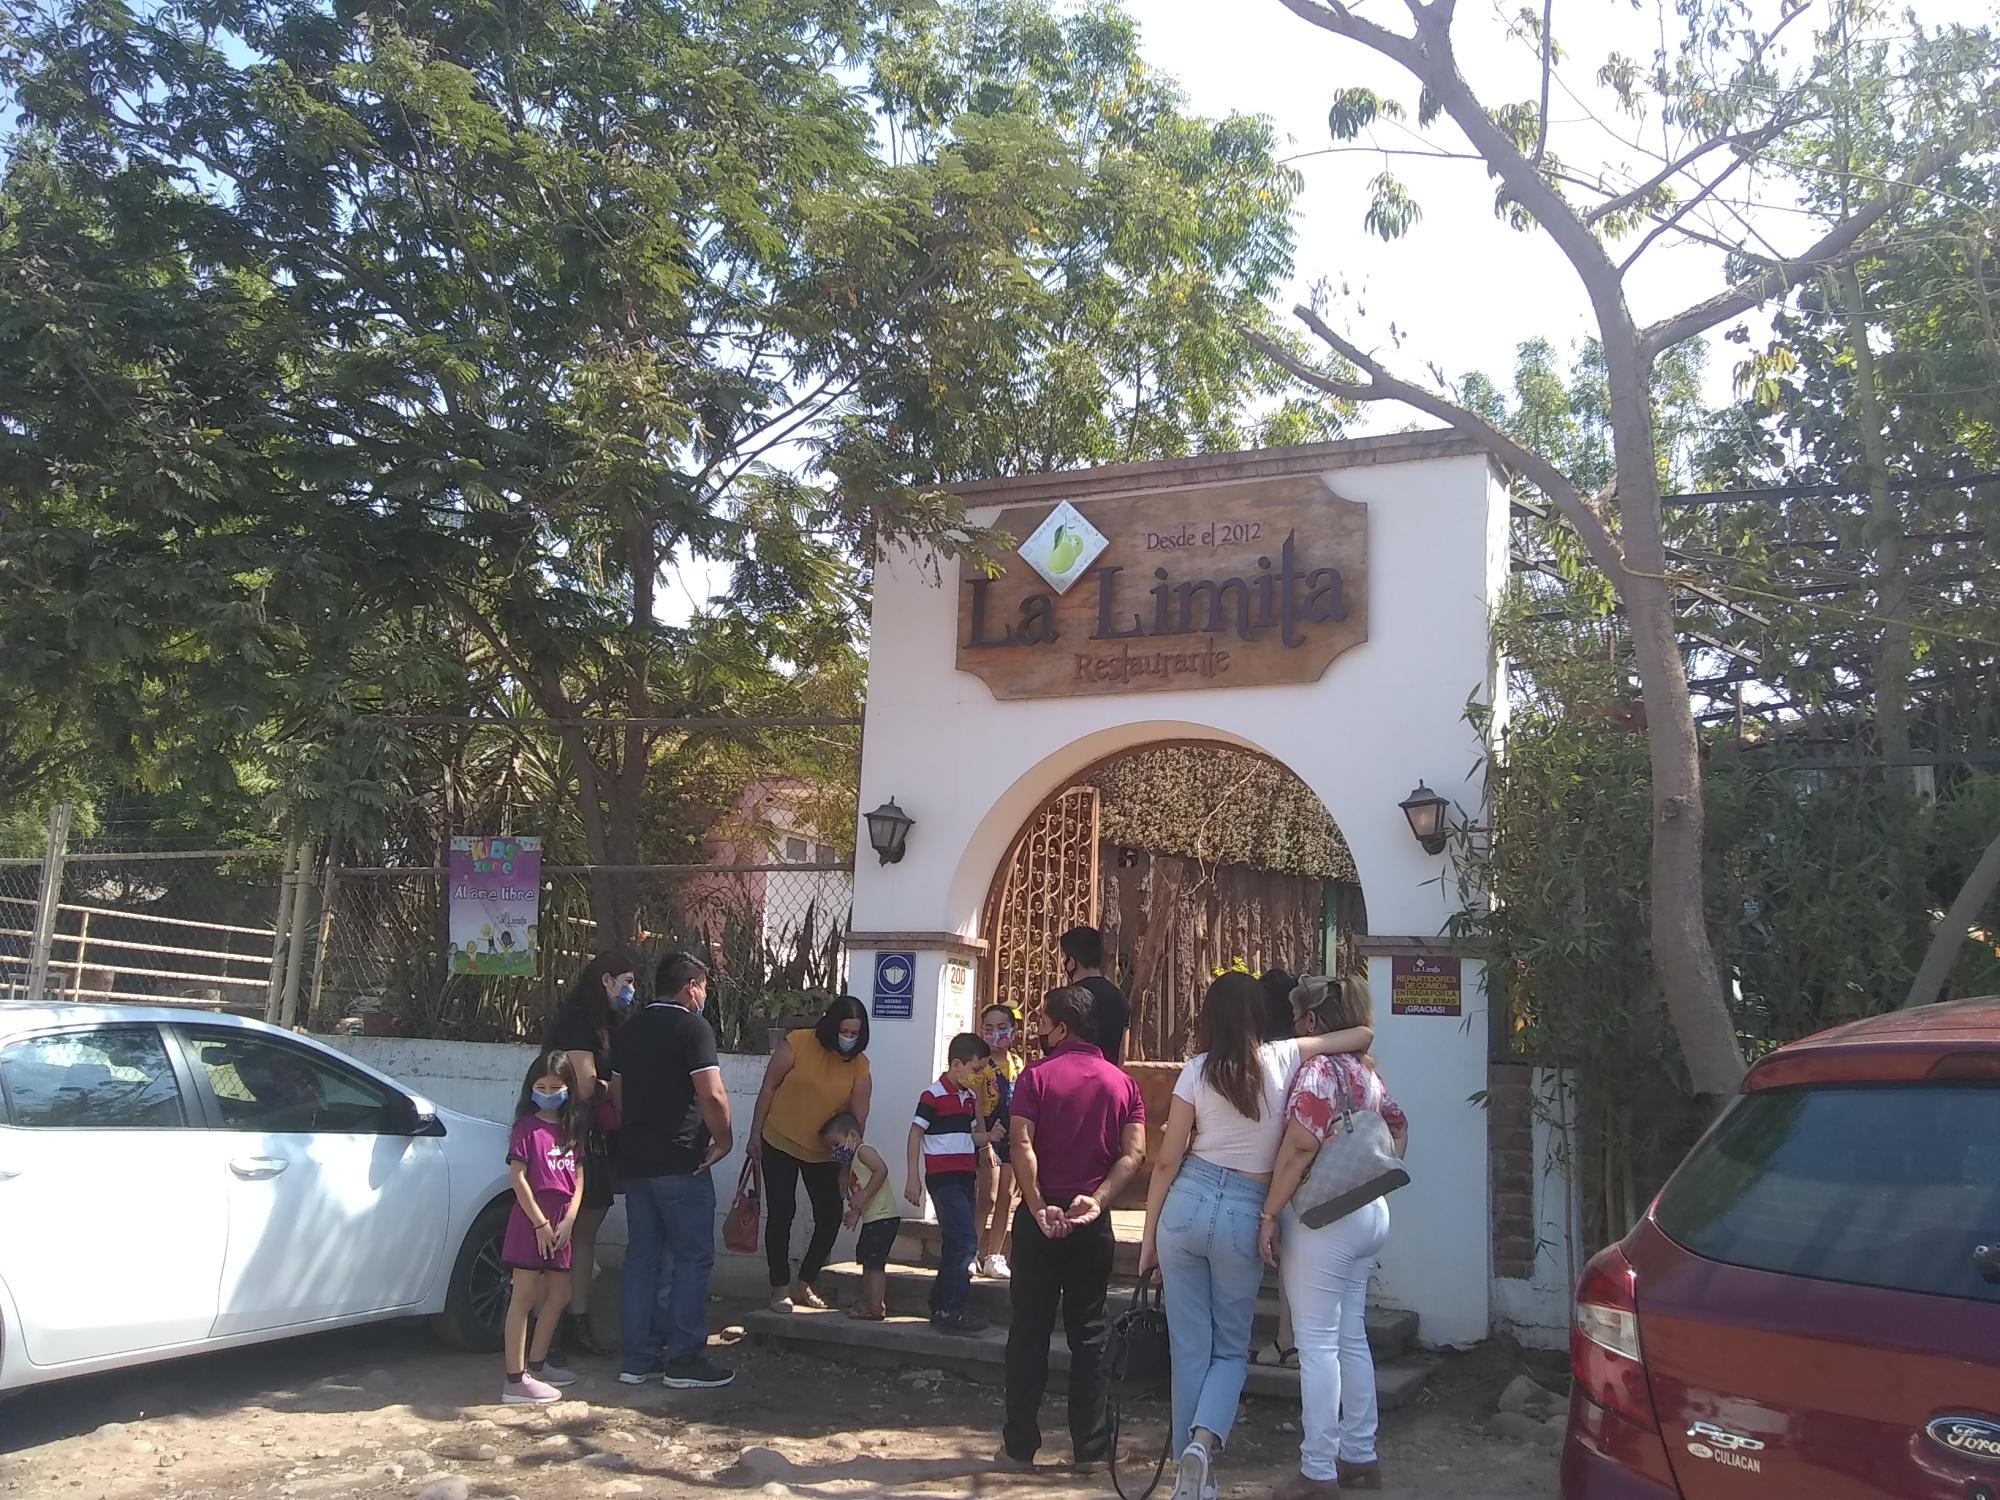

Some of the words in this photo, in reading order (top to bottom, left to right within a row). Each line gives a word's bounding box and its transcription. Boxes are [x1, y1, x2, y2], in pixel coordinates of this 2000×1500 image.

[1146, 528, 1196, 550] Desde
[1201, 526, 1215, 547] el
[1217, 522, 1263, 545] 2012
[963, 578, 1060, 649] La
[1089, 528, 1349, 649] Limita
[1074, 637, 1230, 683] Restaurante
[454, 885, 467, 900] Al
[501, 886, 535, 901] libre
[951, 966, 966, 985] 200
[1396, 975, 1457, 983] REPARTIDORES
[1405, 1005, 1446, 1014] ¡GRACIAS!
[548, 1159, 575, 1172] NOPE
[1686, 1421, 1765, 1450] Figo
[1714, 1448, 1761, 1473] CULIACAN
